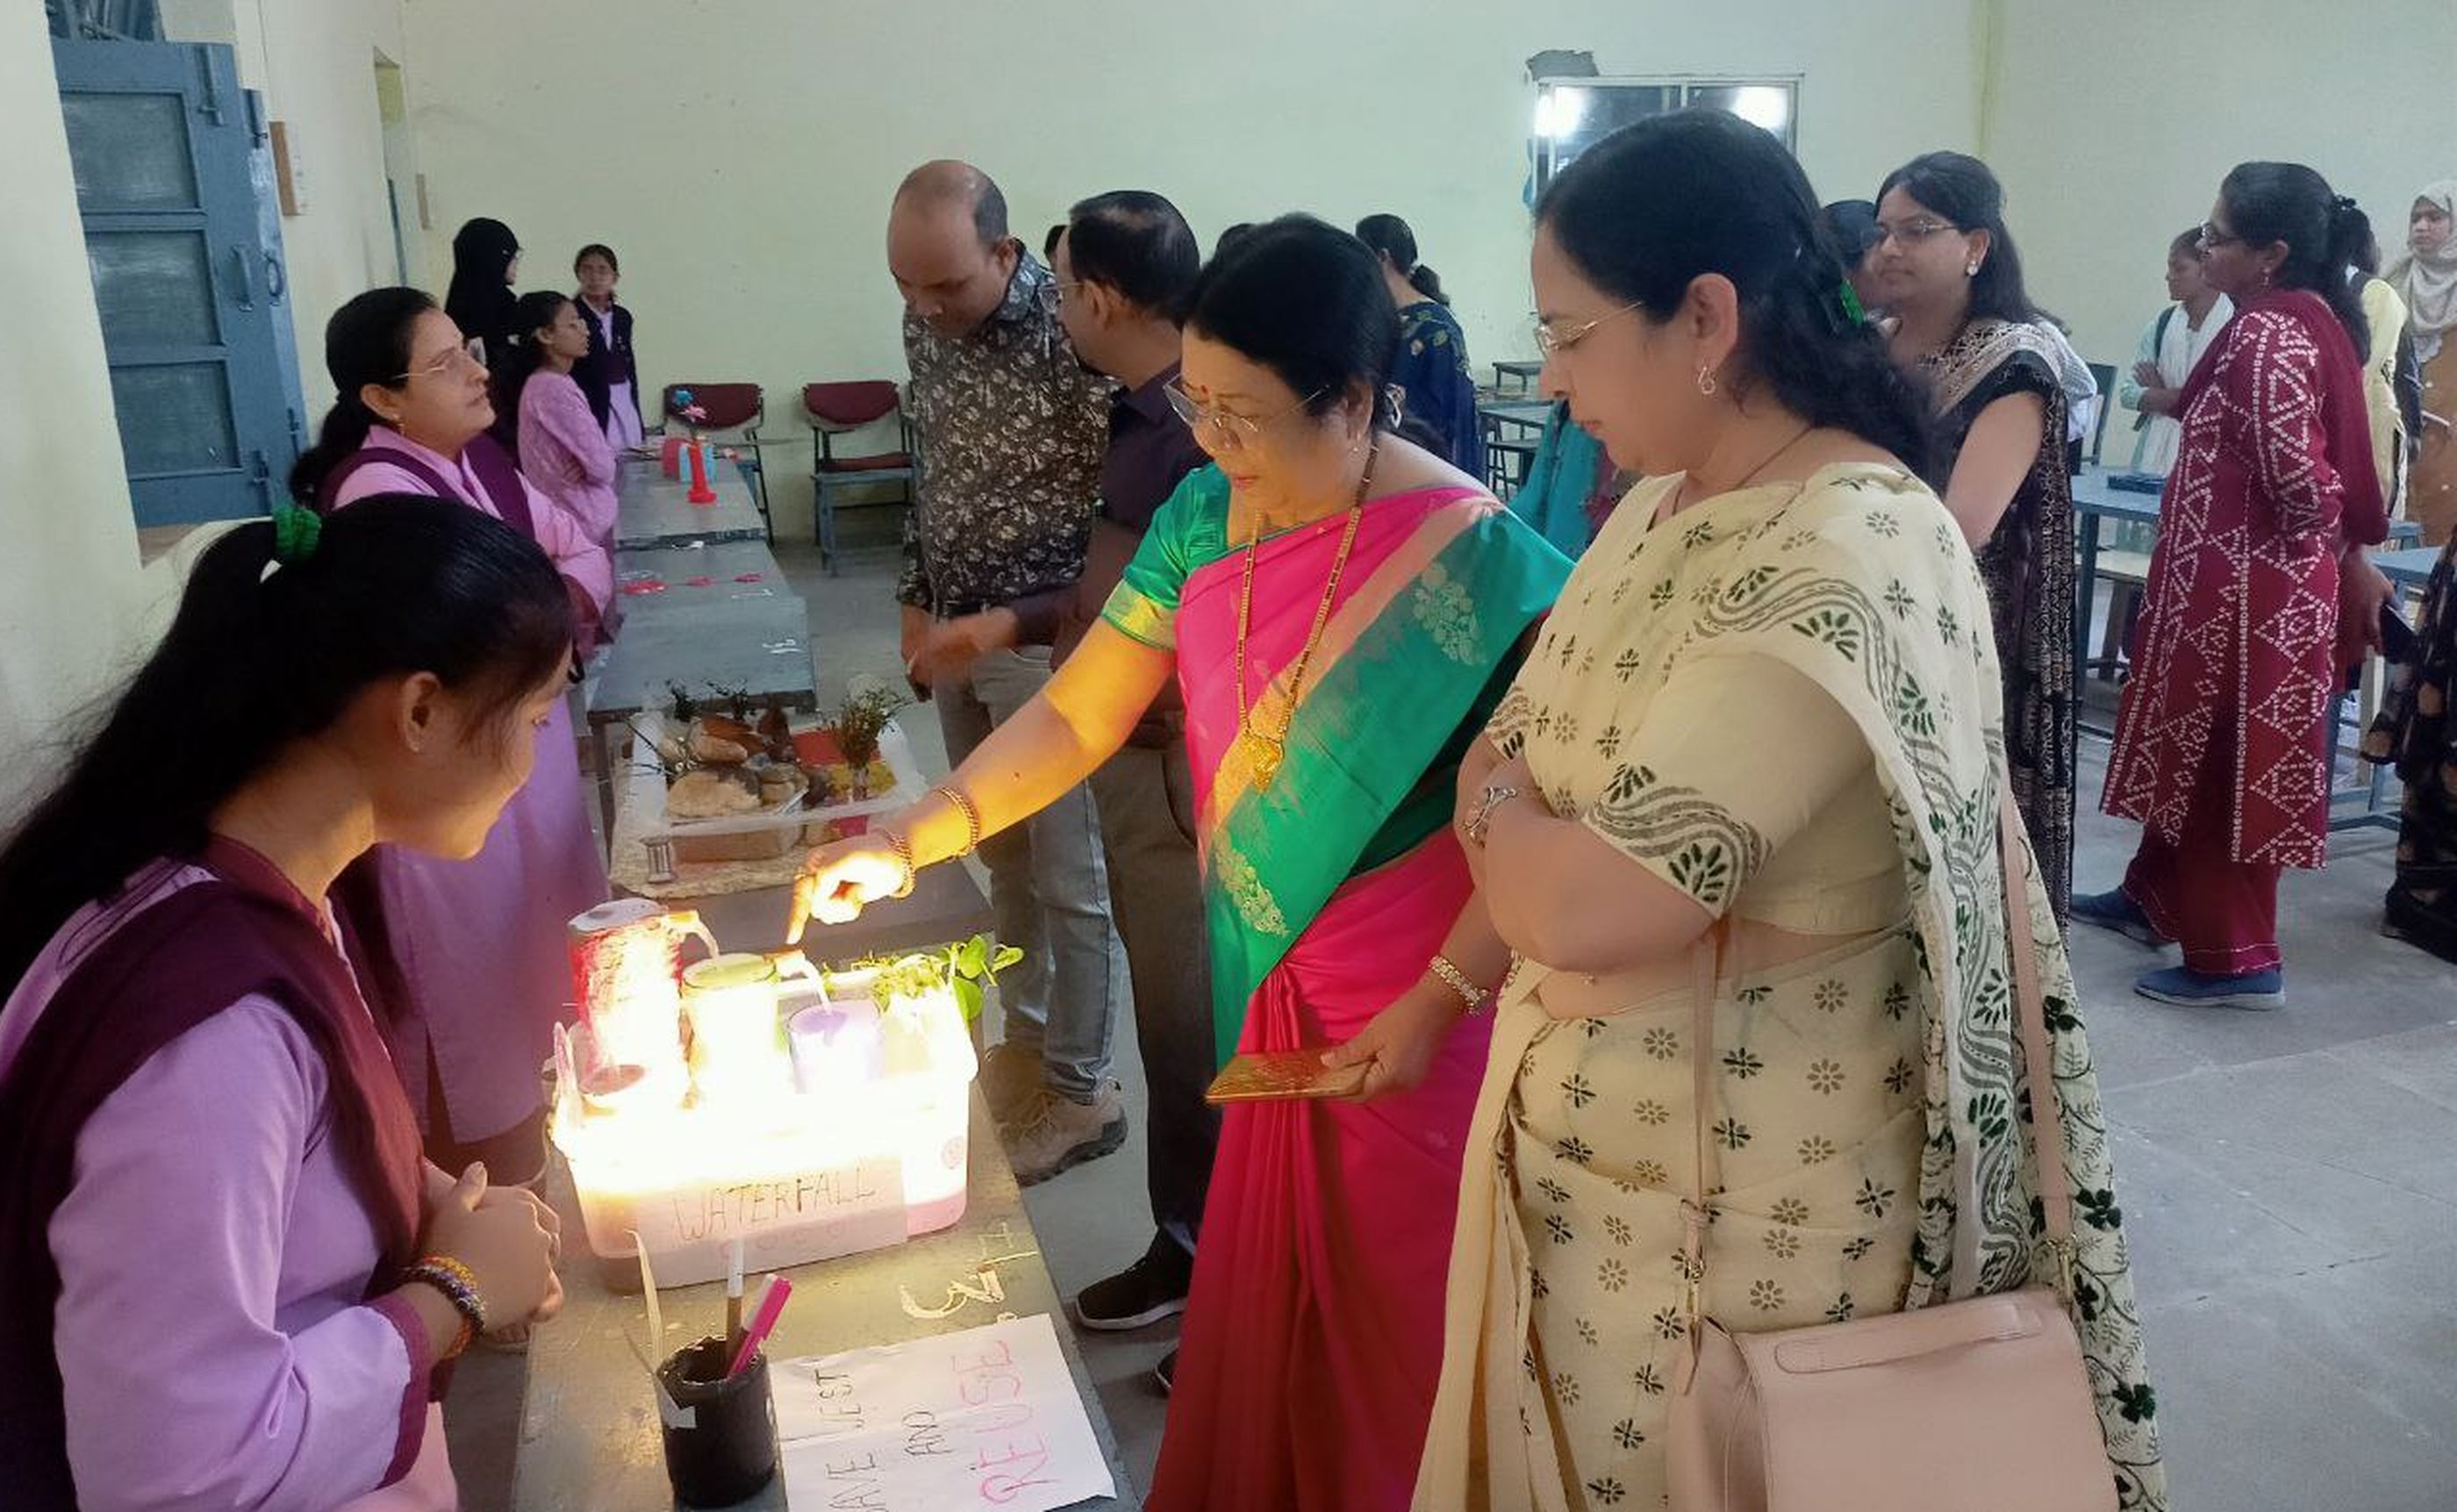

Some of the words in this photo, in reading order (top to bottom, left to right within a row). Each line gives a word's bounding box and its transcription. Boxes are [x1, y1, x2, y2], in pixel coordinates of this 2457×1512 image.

[671, 1160, 876, 1242] WATERFALL
[901, 1410, 955, 1457] AND
[951, 1339, 1060, 1505] REUSE
[824, 1451, 890, 1512] AVE
